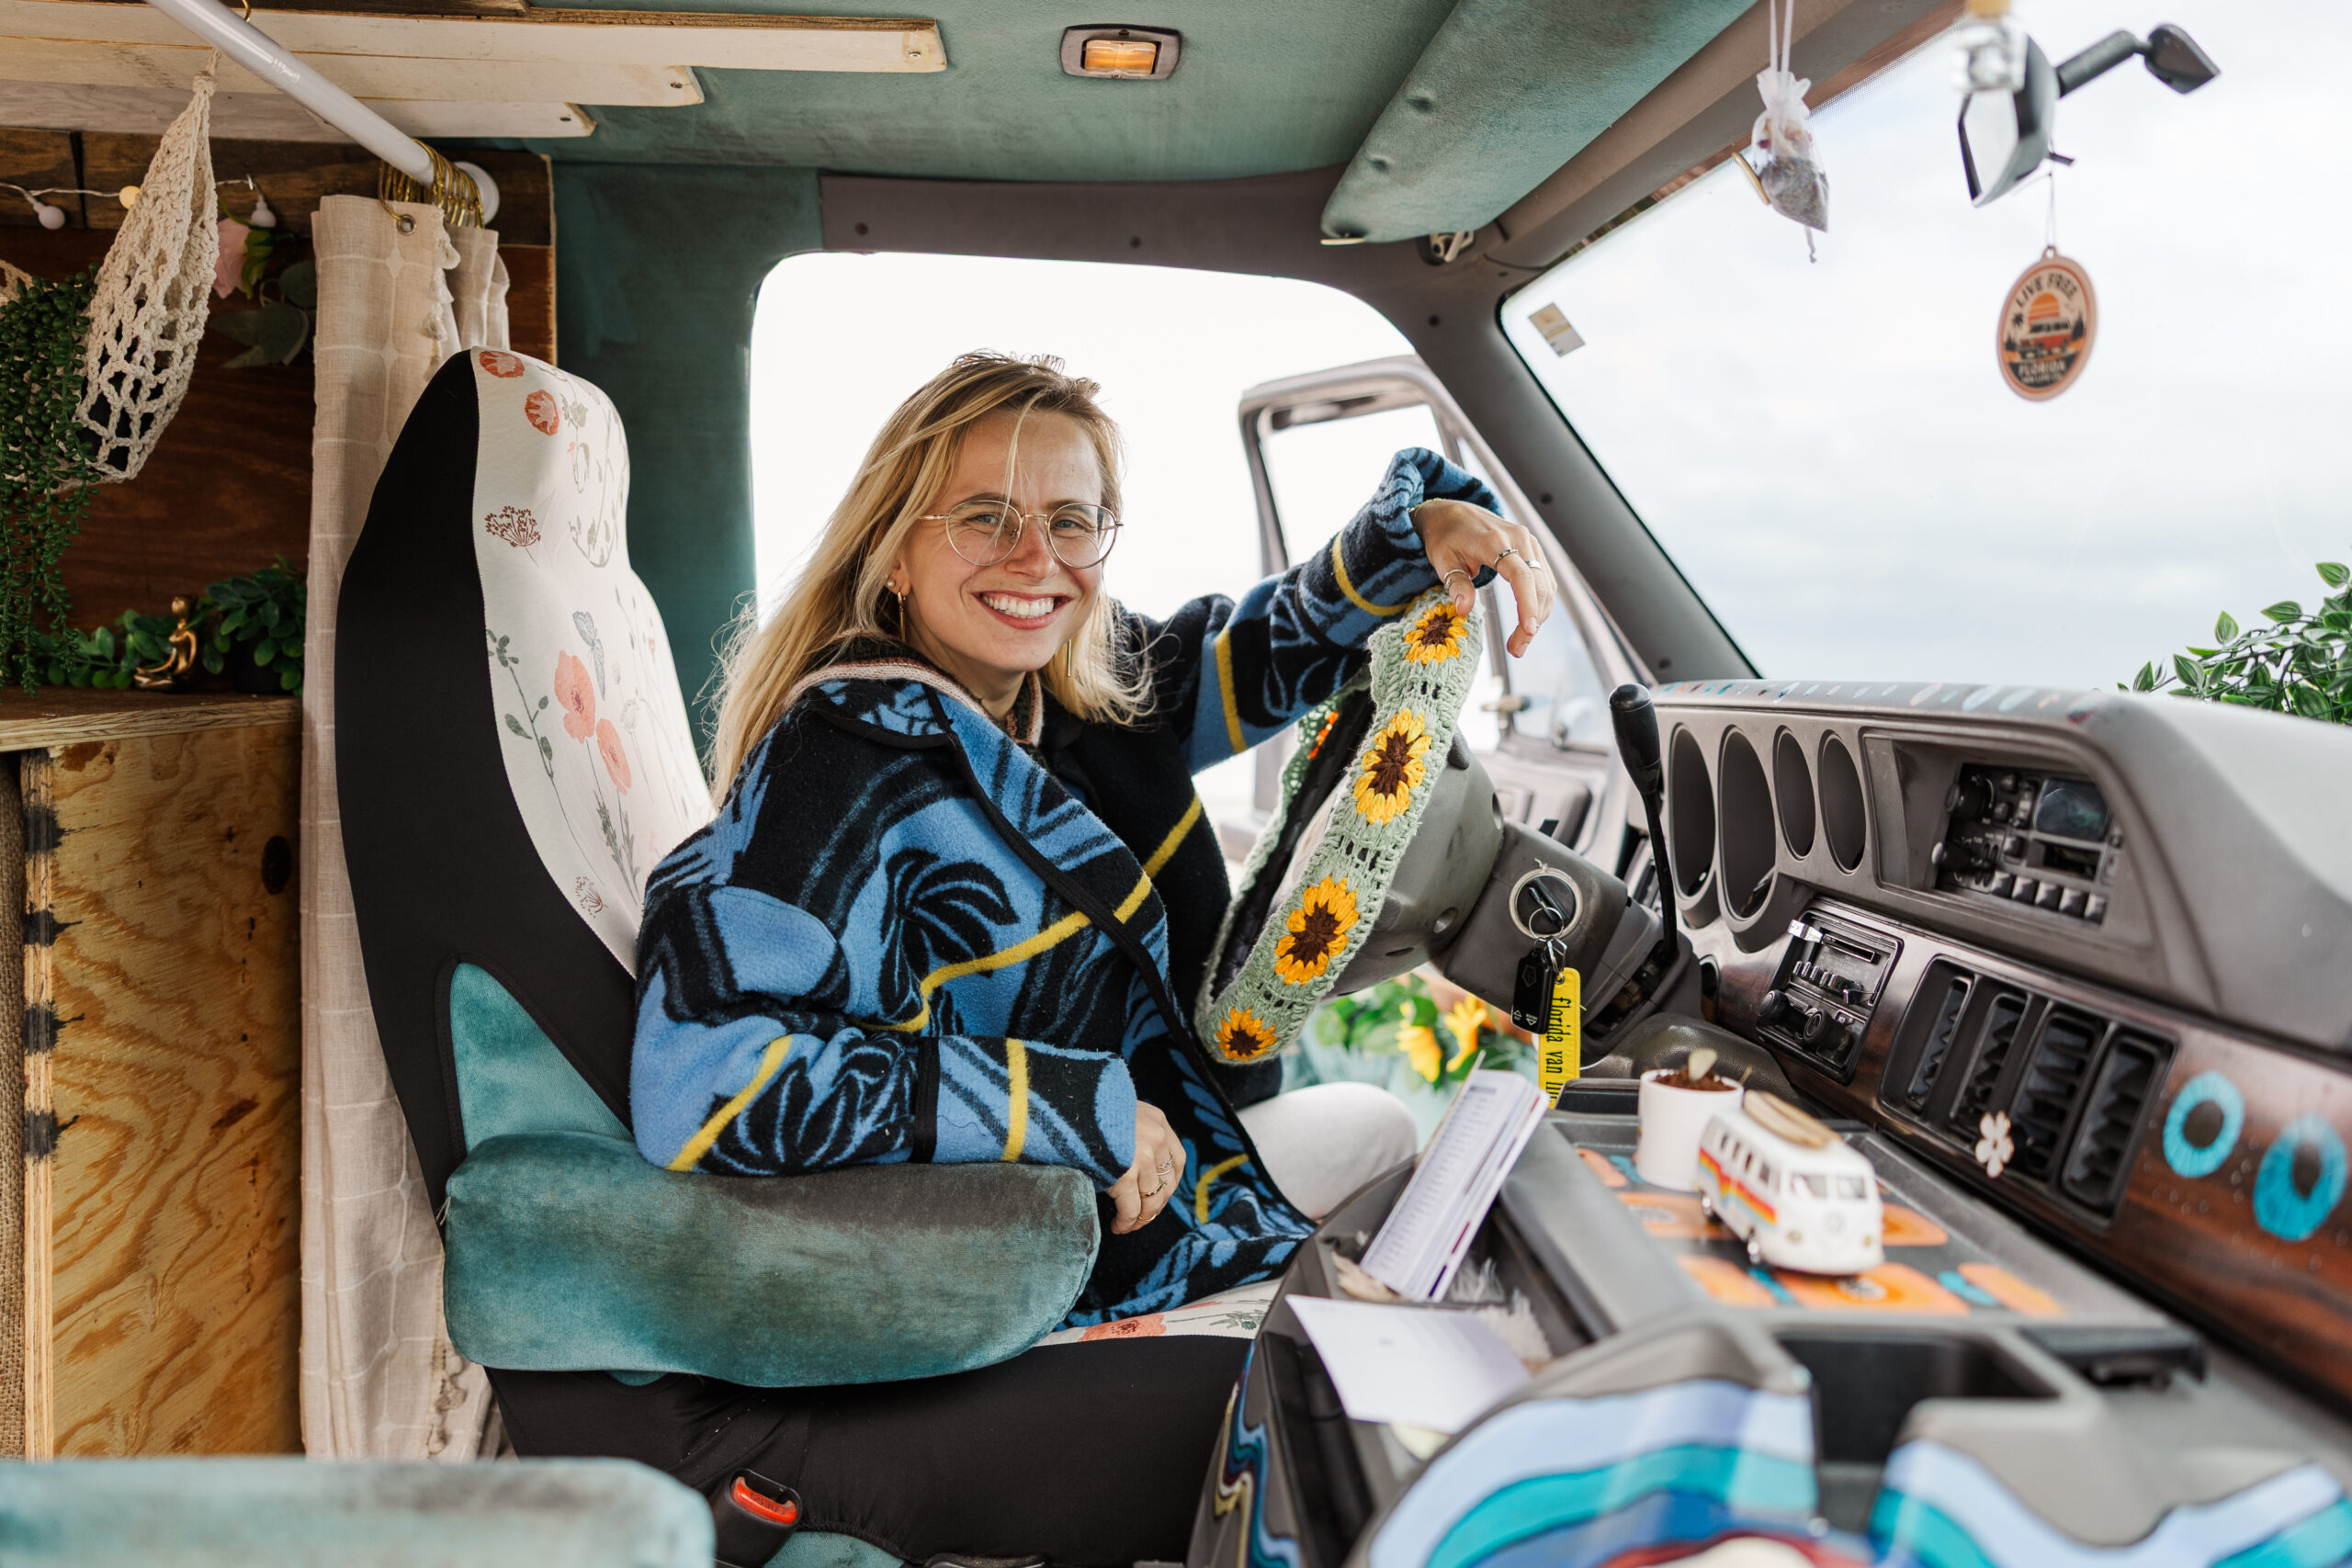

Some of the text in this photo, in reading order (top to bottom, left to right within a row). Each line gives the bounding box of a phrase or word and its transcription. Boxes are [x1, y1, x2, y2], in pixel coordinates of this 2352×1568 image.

[2016, 274, 2077, 308] LIVE FREE
[1546, 1051, 1563, 1074] van
[750, 1493, 786, 1515] PRESS
